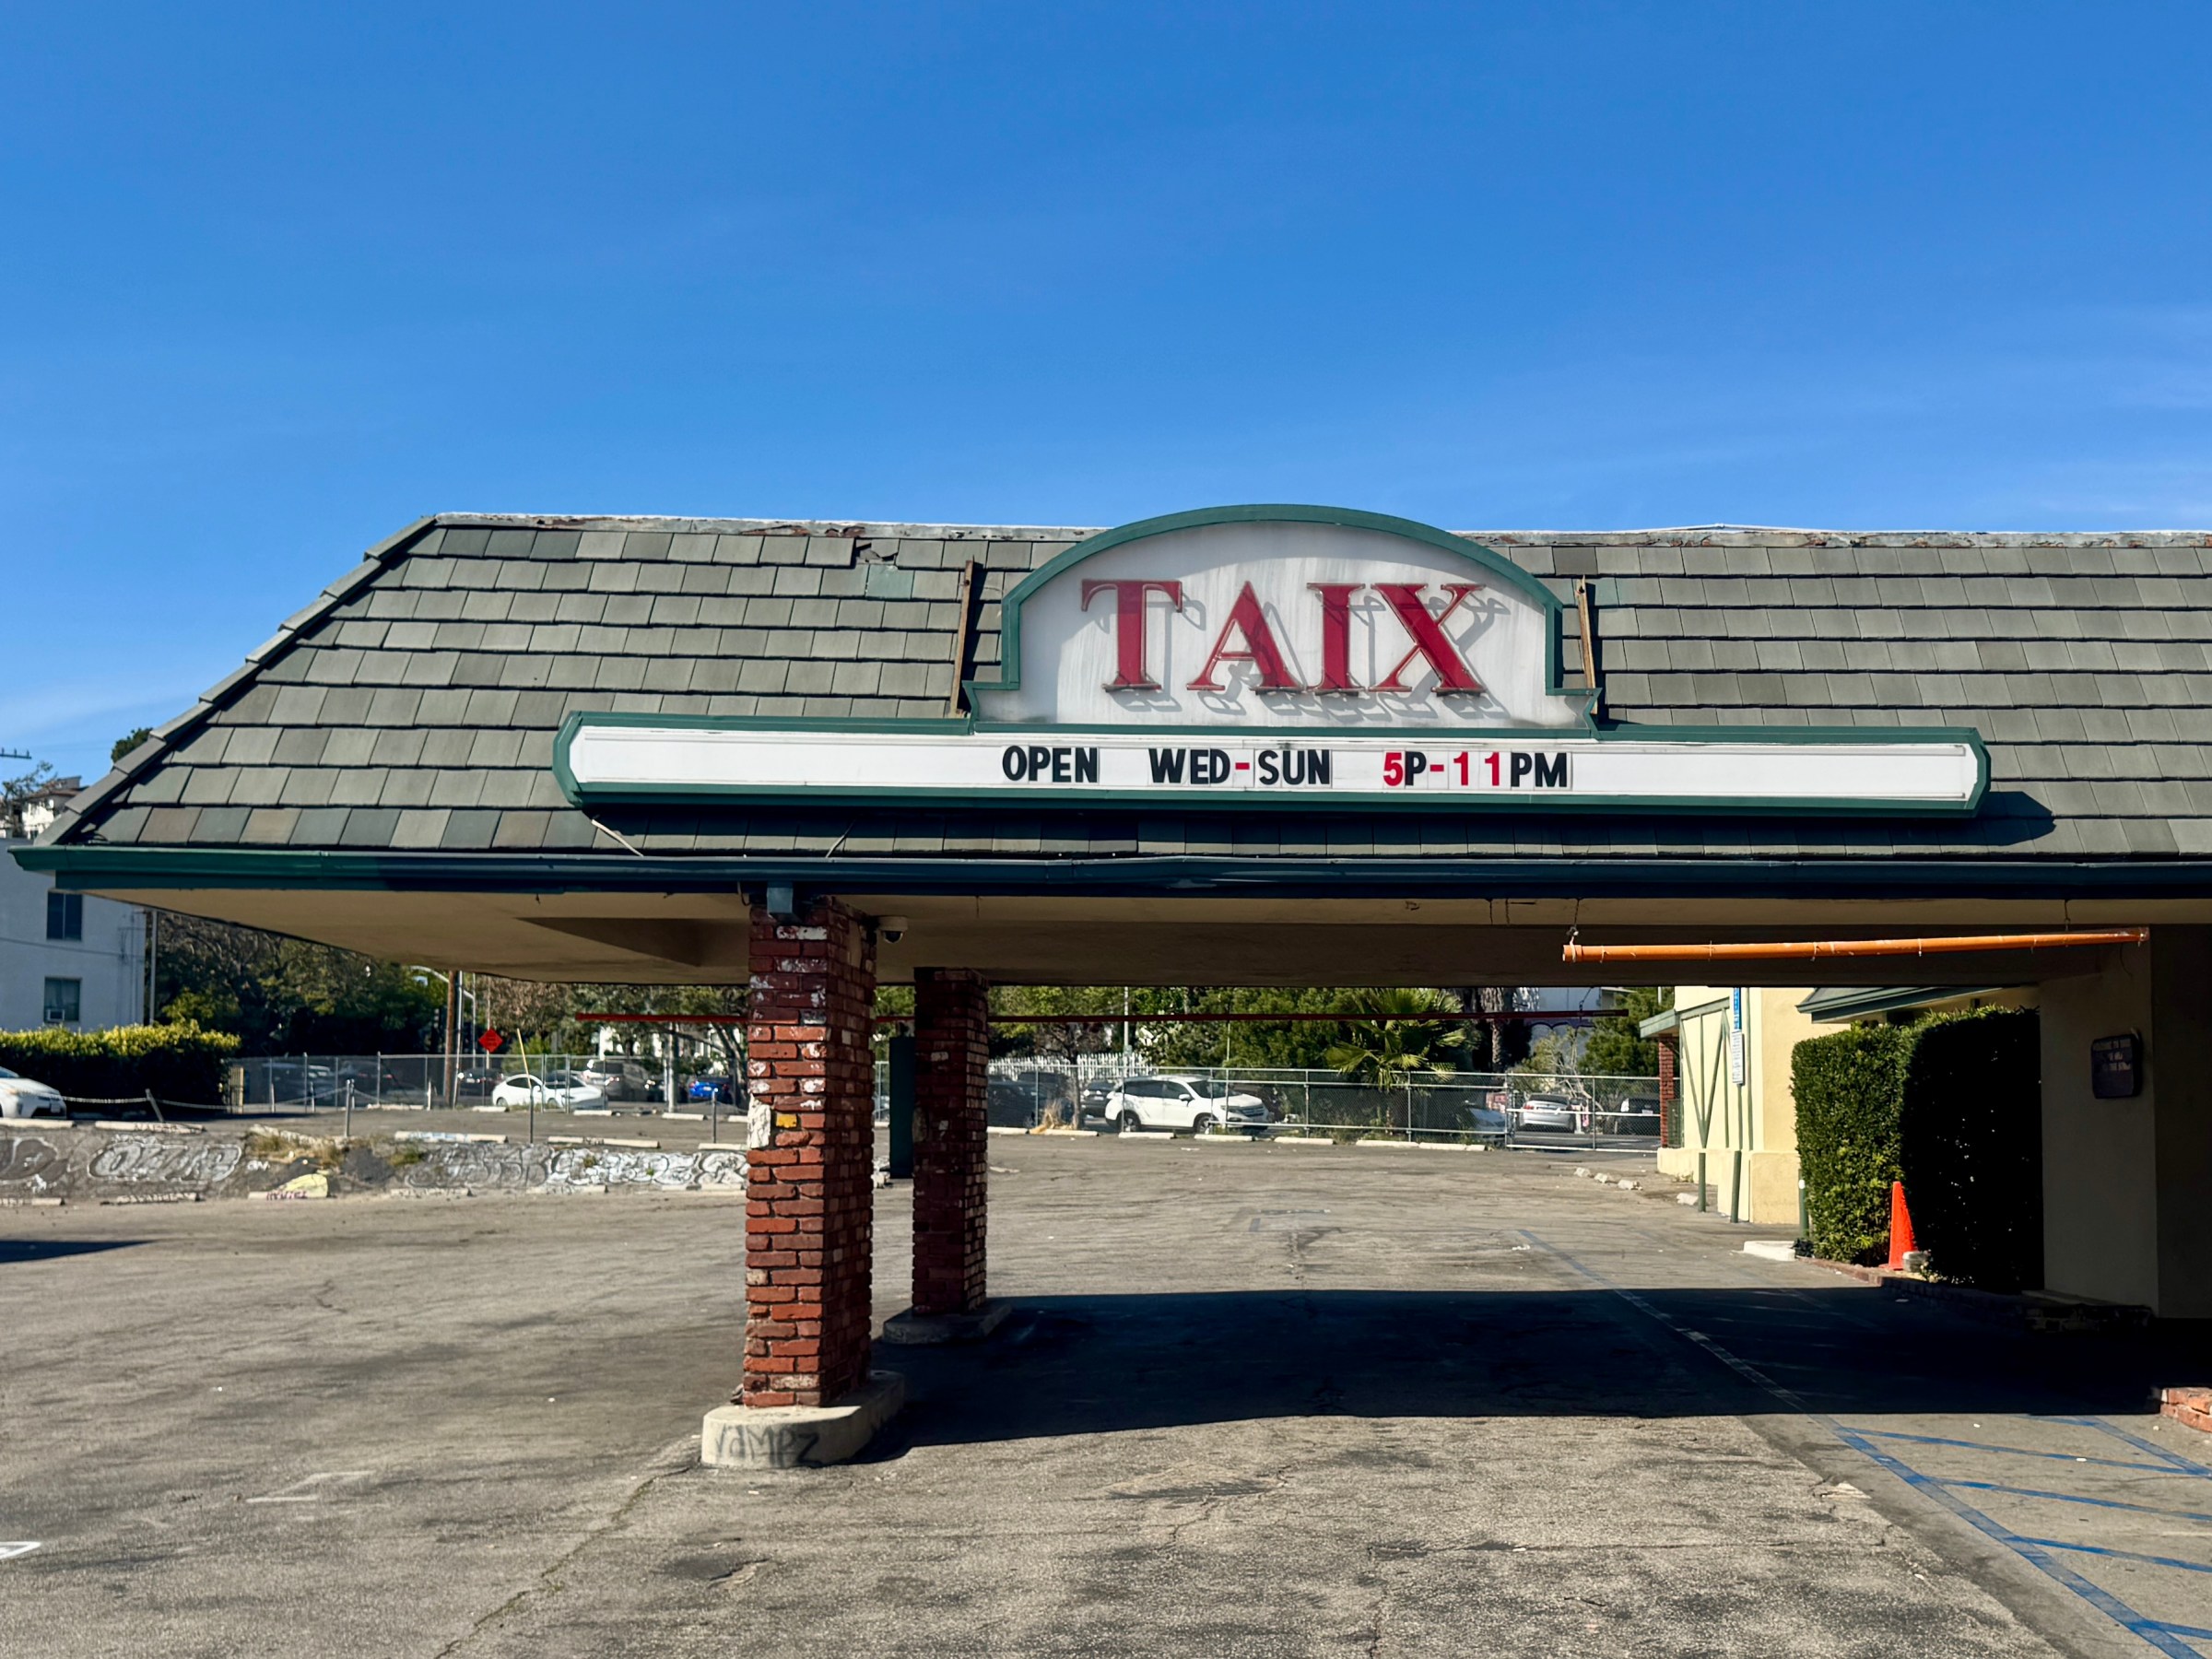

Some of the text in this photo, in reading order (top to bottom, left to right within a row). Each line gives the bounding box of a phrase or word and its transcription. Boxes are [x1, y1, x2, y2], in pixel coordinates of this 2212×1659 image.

[1081, 579, 1488, 694] TAIX
[1002, 745, 1568, 787] OPEN WED-SUN 5P-11PM
